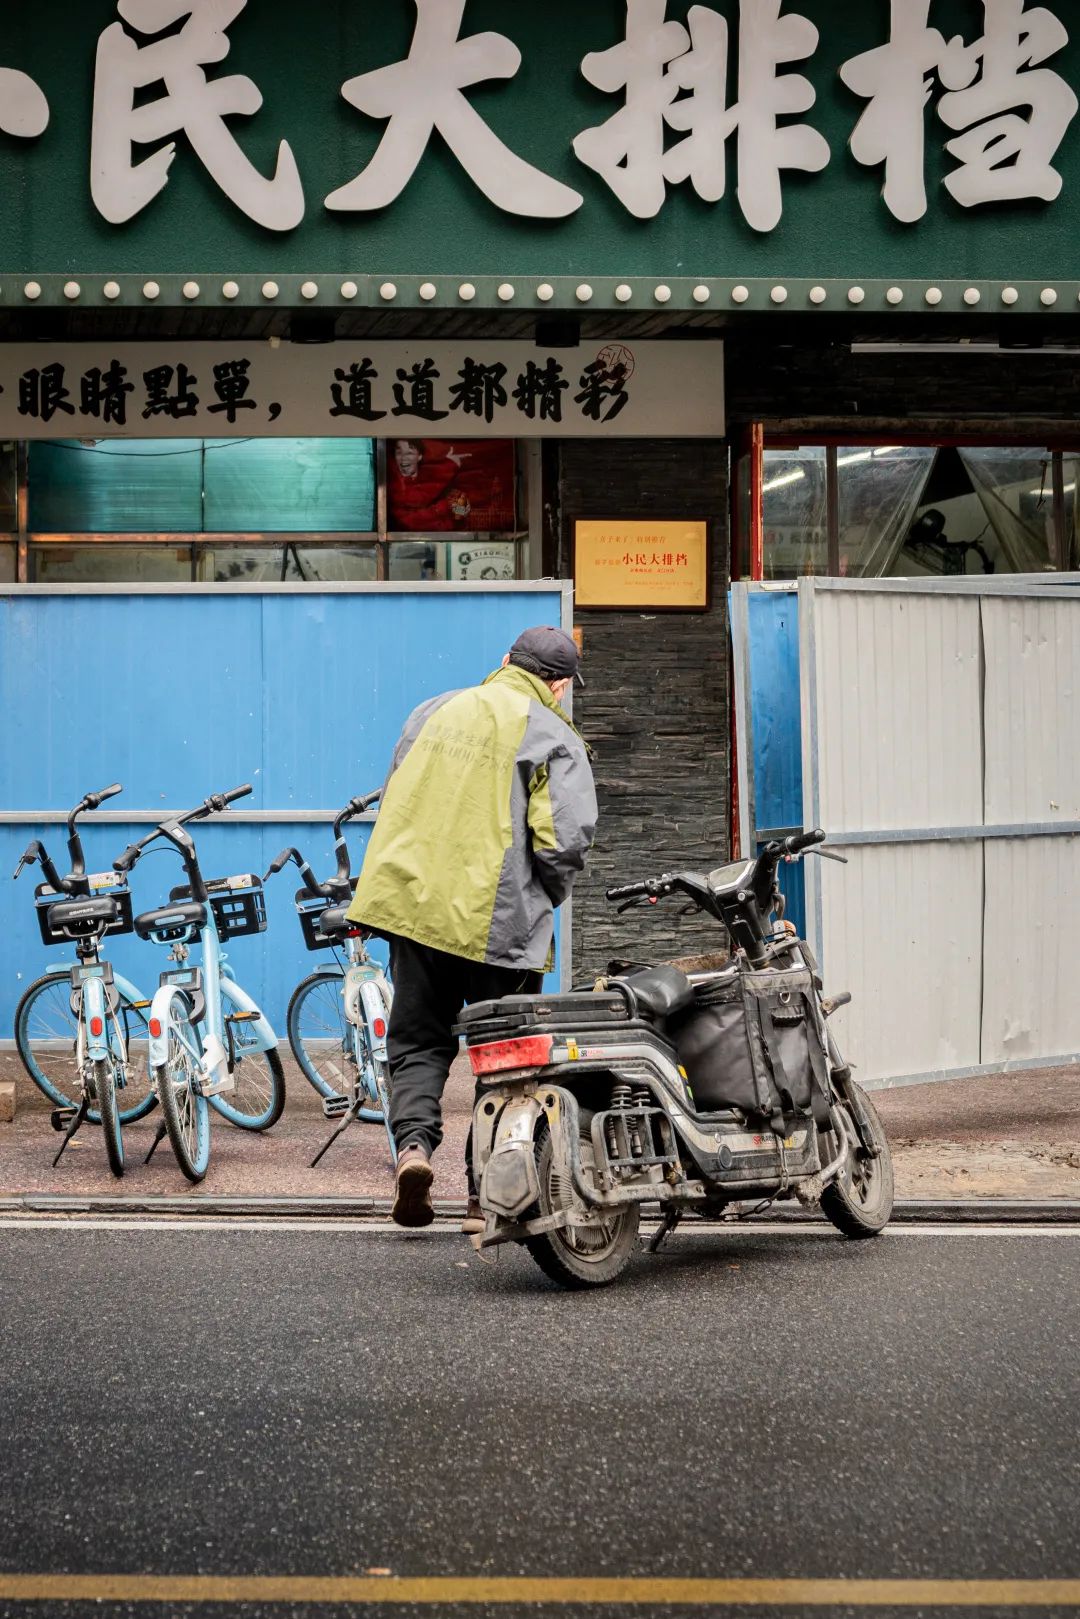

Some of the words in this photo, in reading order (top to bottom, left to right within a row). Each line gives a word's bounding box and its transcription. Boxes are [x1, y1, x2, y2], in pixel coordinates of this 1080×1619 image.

[0, 0, 1079, 232] 民大排档
[328, 357, 630, 424] 道道都精彩
[622, 552, 688, 566] 小民大排档
